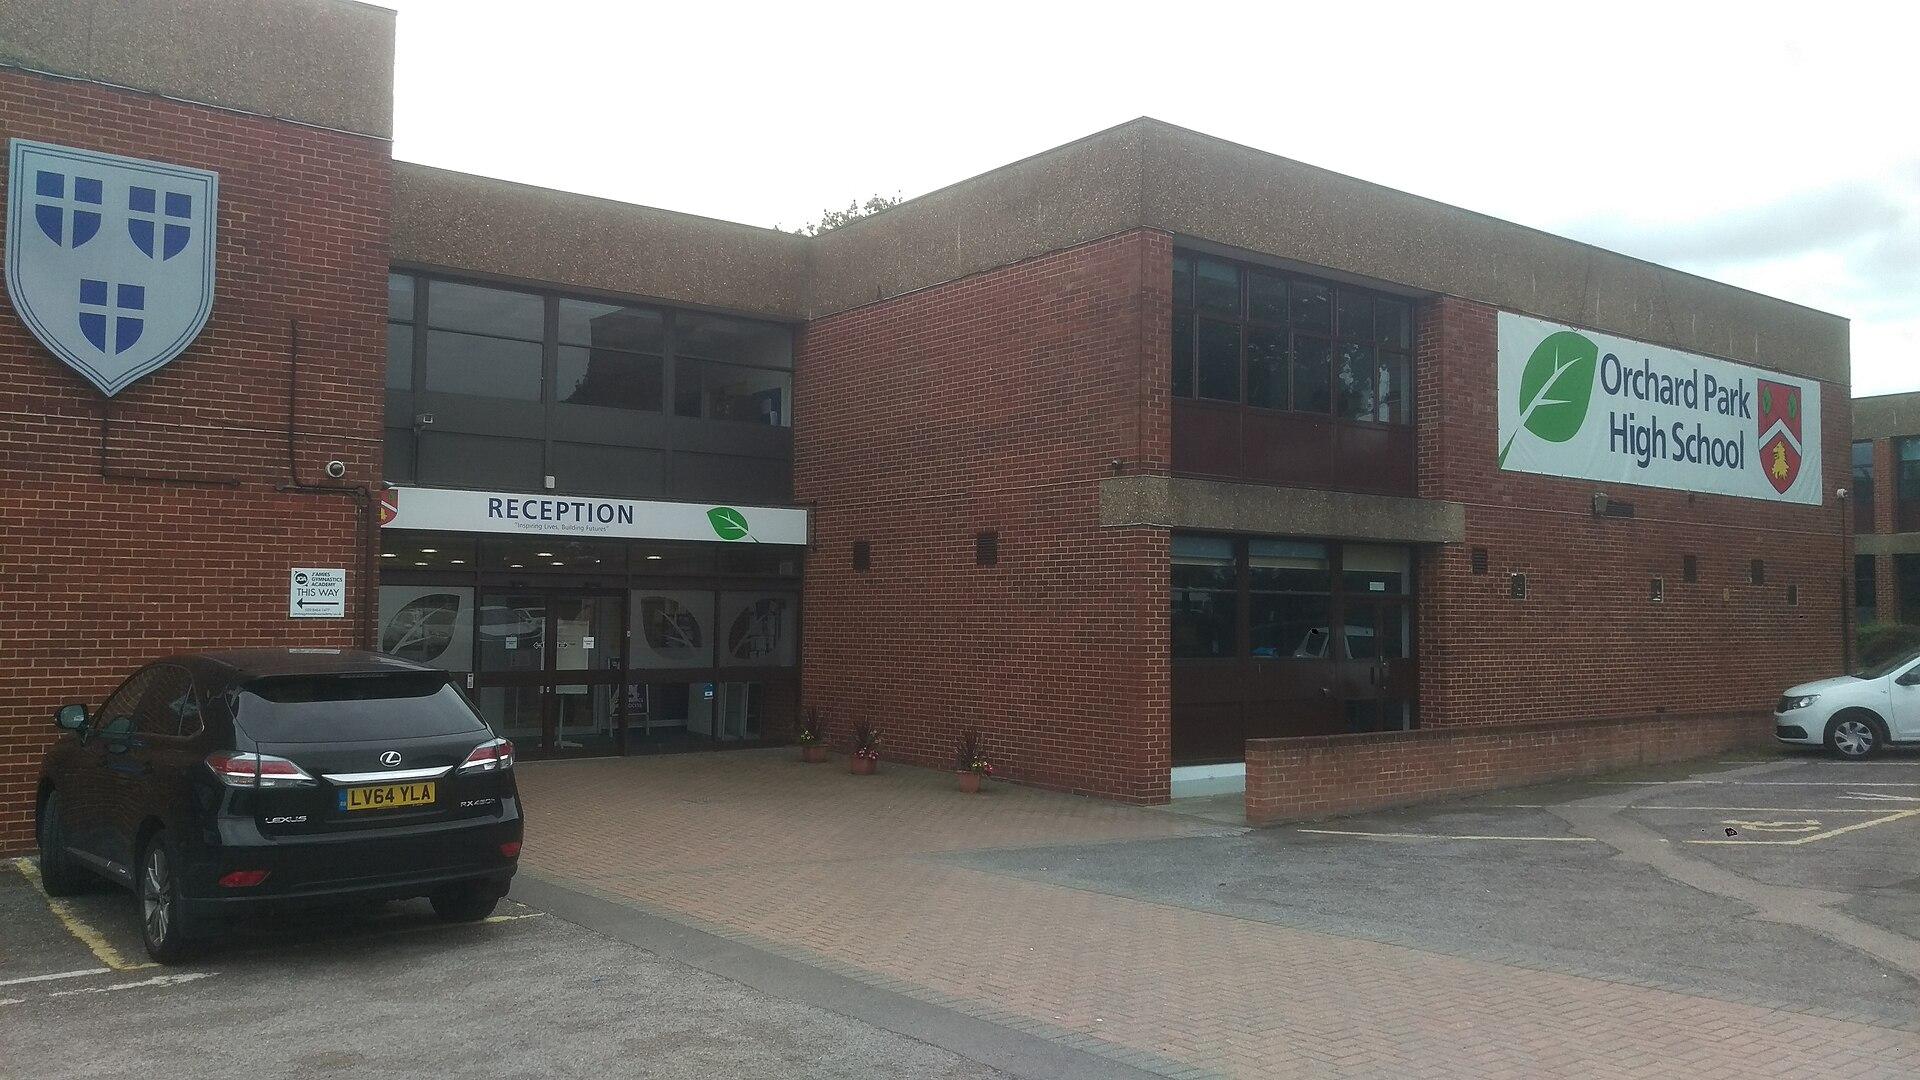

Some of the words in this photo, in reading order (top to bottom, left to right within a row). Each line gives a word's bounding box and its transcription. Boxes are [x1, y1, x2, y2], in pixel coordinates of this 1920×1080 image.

[1600, 352, 1698, 410] Orchard
[1704, 373, 1752, 420] Park
[1609, 411, 1667, 469] High
[1671, 421, 1745, 470] School
[488, 497, 634, 525] RECEPTION
[561, 524, 585, 532] Building
[297, 588, 316, 597] THIS
[318, 588, 340, 597] WAY
[350, 787, 395, 807] LV64
[399, 784, 431, 801] YLA
[265, 815, 307, 824] LEXUS
